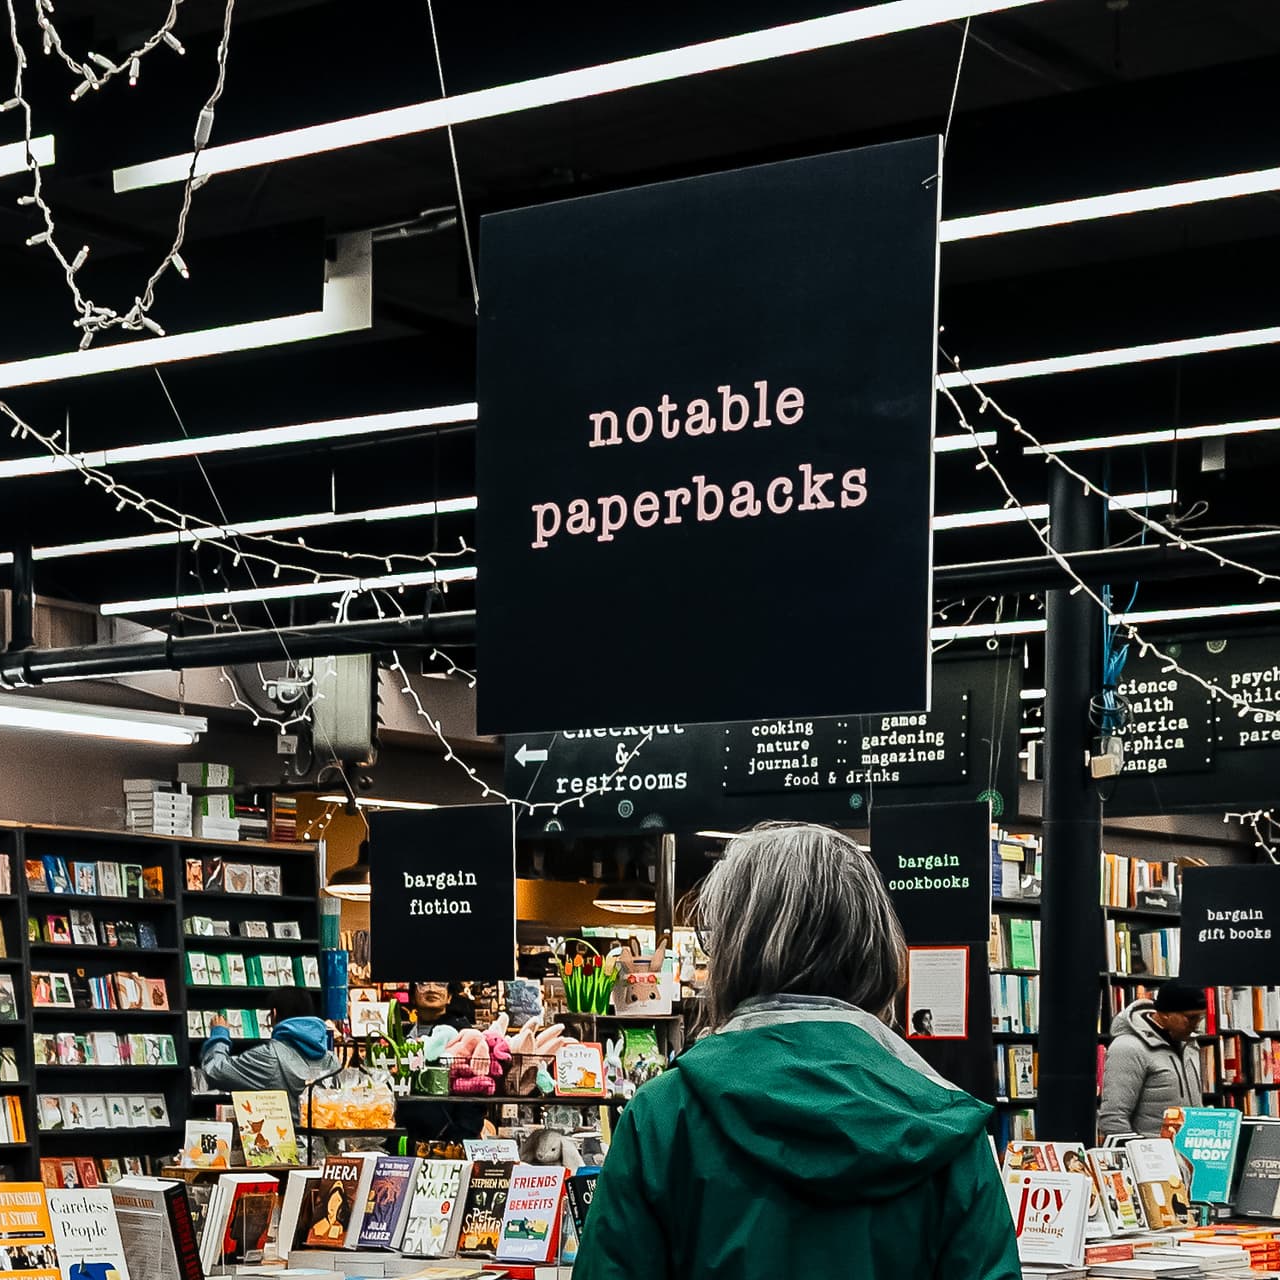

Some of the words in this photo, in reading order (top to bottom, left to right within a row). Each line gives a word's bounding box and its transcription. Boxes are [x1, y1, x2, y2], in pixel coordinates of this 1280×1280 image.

[589, 380, 805, 447] notable
[531, 464, 868, 548] paperbacks
[751, 719, 815, 739] cooking
[881, 711, 928, 730] games
[755, 737, 811, 754] nature
[861, 729, 945, 750] gardening
[615, 743, 629, 764] &
[747, 754, 819, 775] journals
[860, 747, 946, 767] magazines
[556, 772, 688, 794] restrooms
[783, 771, 821, 787] food
[828, 770, 838, 785] &
[845, 766, 901, 785] drinks
[897, 854, 961, 870] bargain
[403, 870, 477, 890] bargain
[888, 873, 971, 891] cookbooks
[409, 898, 472, 915] fiction
[1207, 908, 1264, 922] bargain
[1199, 928, 1225, 942] gift
[1230, 928, 1272, 939] books
[1183, 1136, 1232, 1149] HUMAN
[1202, 1147, 1229, 1162] BODY
[324, 1164, 358, 1181] HERA
[419, 1160, 462, 1180] RUTH
[415, 1180, 458, 1199] WARE
[470, 1178, 497, 1189] STEPHEN
[513, 1175, 558, 1189] FRIENDS
[50, 1196, 110, 1216] Careless
[509, 1199, 553, 1211] BENEFITS
[1017, 1177, 1071, 1237] joy
[1028, 1212, 1039, 1223] of
[60, 1219, 108, 1238] People
[1024, 1223, 1065, 1238] cooking
